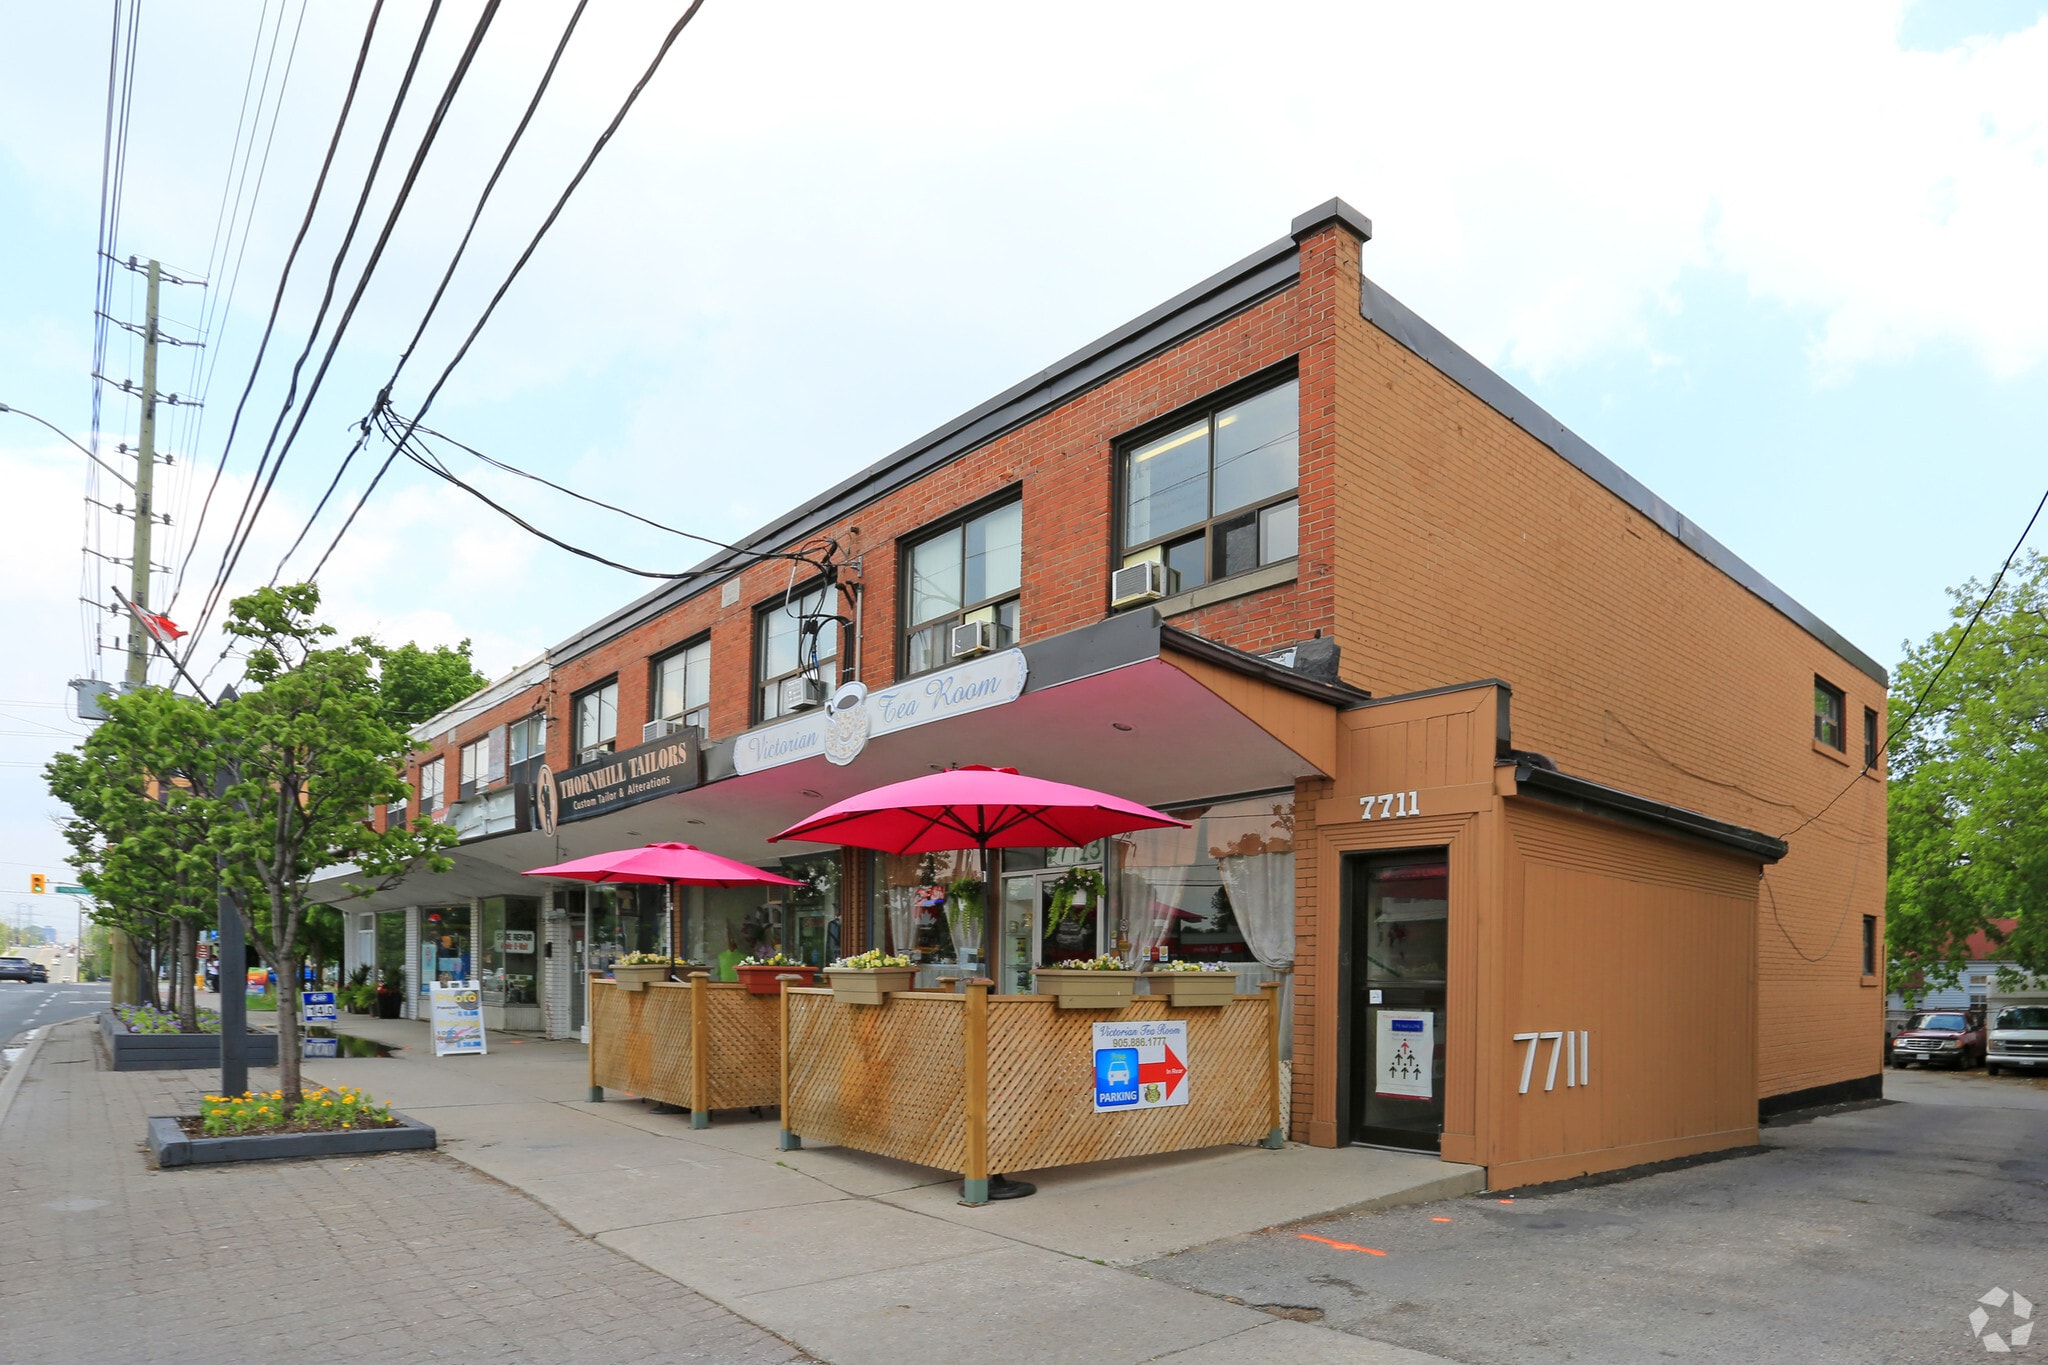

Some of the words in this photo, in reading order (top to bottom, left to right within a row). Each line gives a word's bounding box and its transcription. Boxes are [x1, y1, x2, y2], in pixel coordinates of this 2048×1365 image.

[748, 731, 817, 760] Victorian
[879, 693, 919, 723] Tea
[926, 676, 1000, 710] Room
[559, 762, 626, 799] THORNHILL
[628, 742, 687, 779] TAILORS
[573, 797, 597, 810] Custom
[598, 791, 617, 804] Tailor
[618, 787, 624, 798] &
[627, 775, 671, 796] Alterations
[1360, 791, 1420, 820] 7711
[435, 992, 478, 1004] Photo
[1099, 1025, 1138, 1037] Victorian
[1139, 1024, 1156, 1036] Tea
[1157, 1023, 1181, 1035] Room
[1112, 1037, 1167, 1048] 905.886.1777
[1513, 1031, 1588, 1094] 7711
[1099, 1091, 1137, 1103] PARKING
